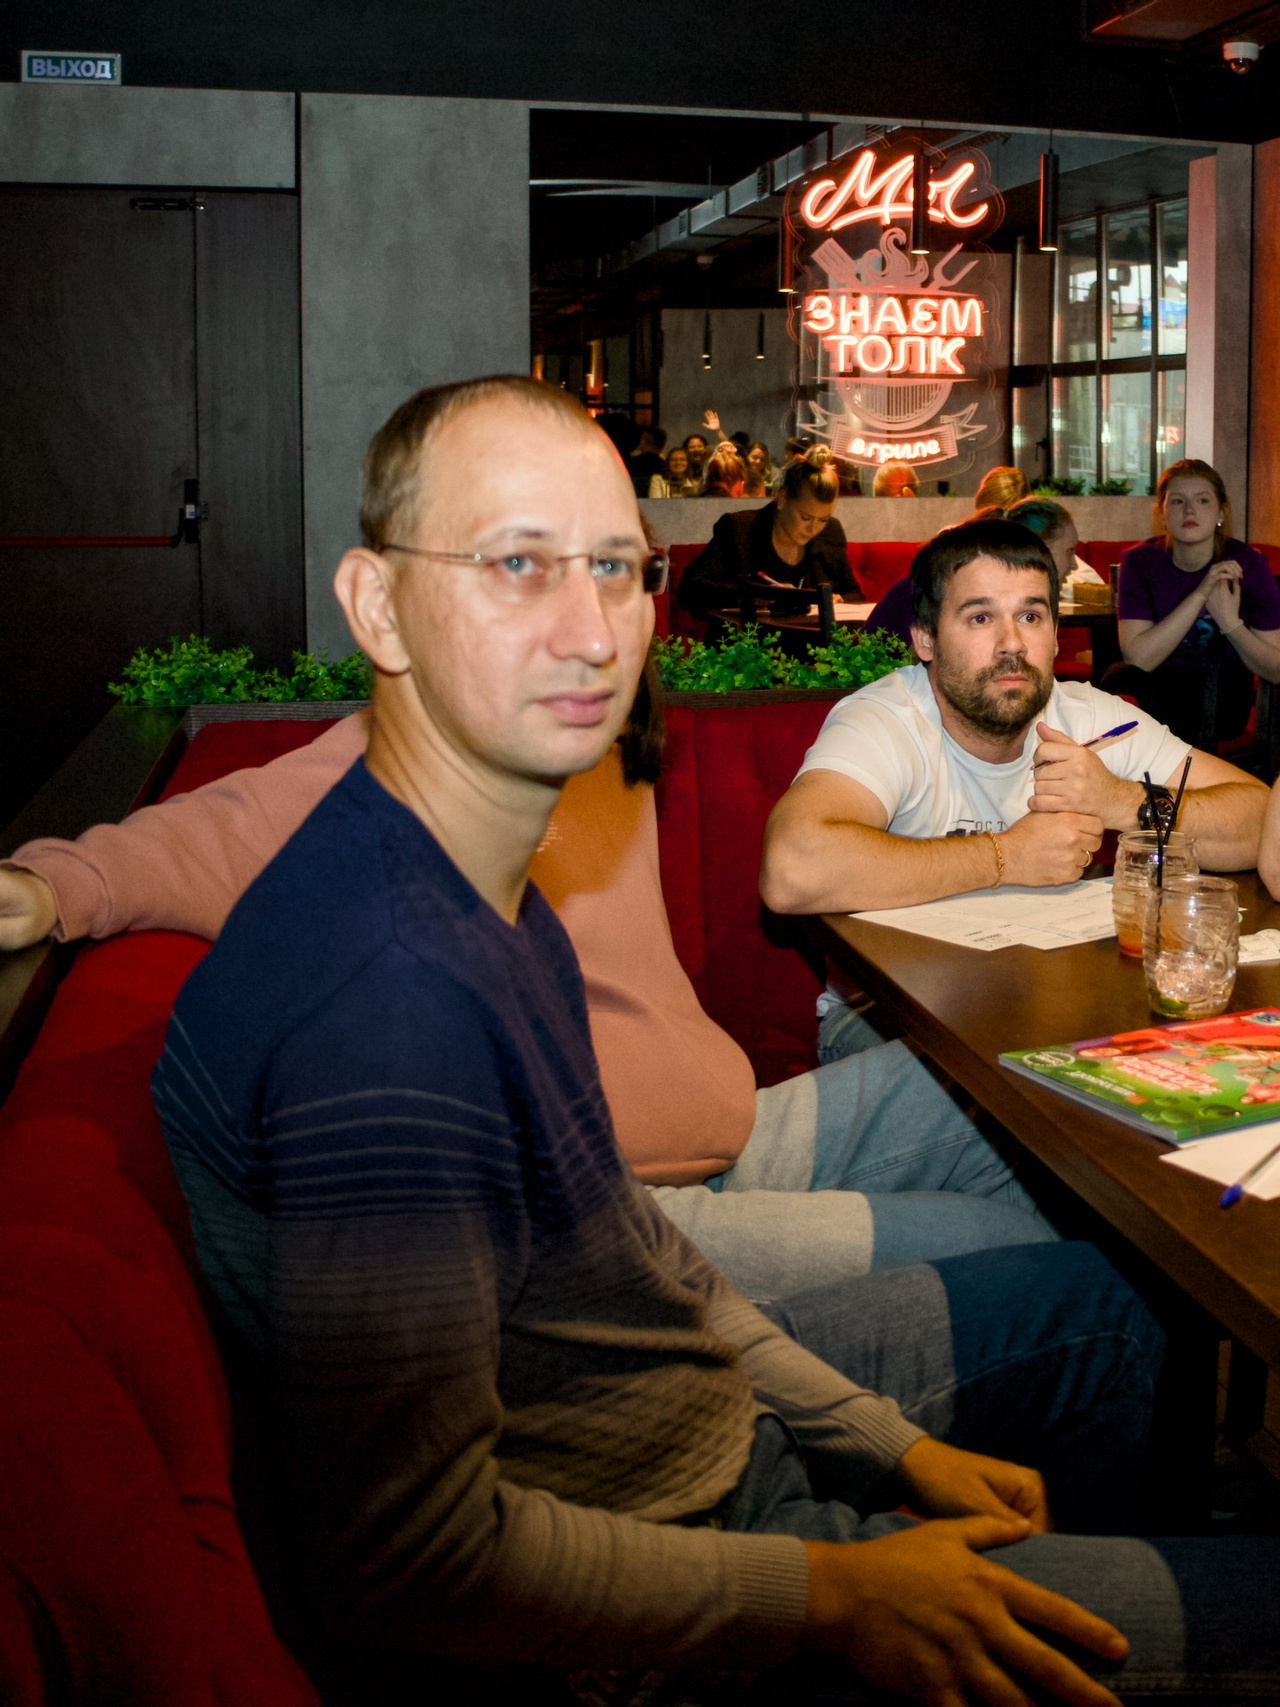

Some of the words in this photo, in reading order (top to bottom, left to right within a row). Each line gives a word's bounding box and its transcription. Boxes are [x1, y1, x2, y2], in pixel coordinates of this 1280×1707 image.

[32, 58, 111, 78] ВЫХОД
[805, 295, 983, 336] ЗНАЕМ
[825, 334, 966, 375] ТОЛК
